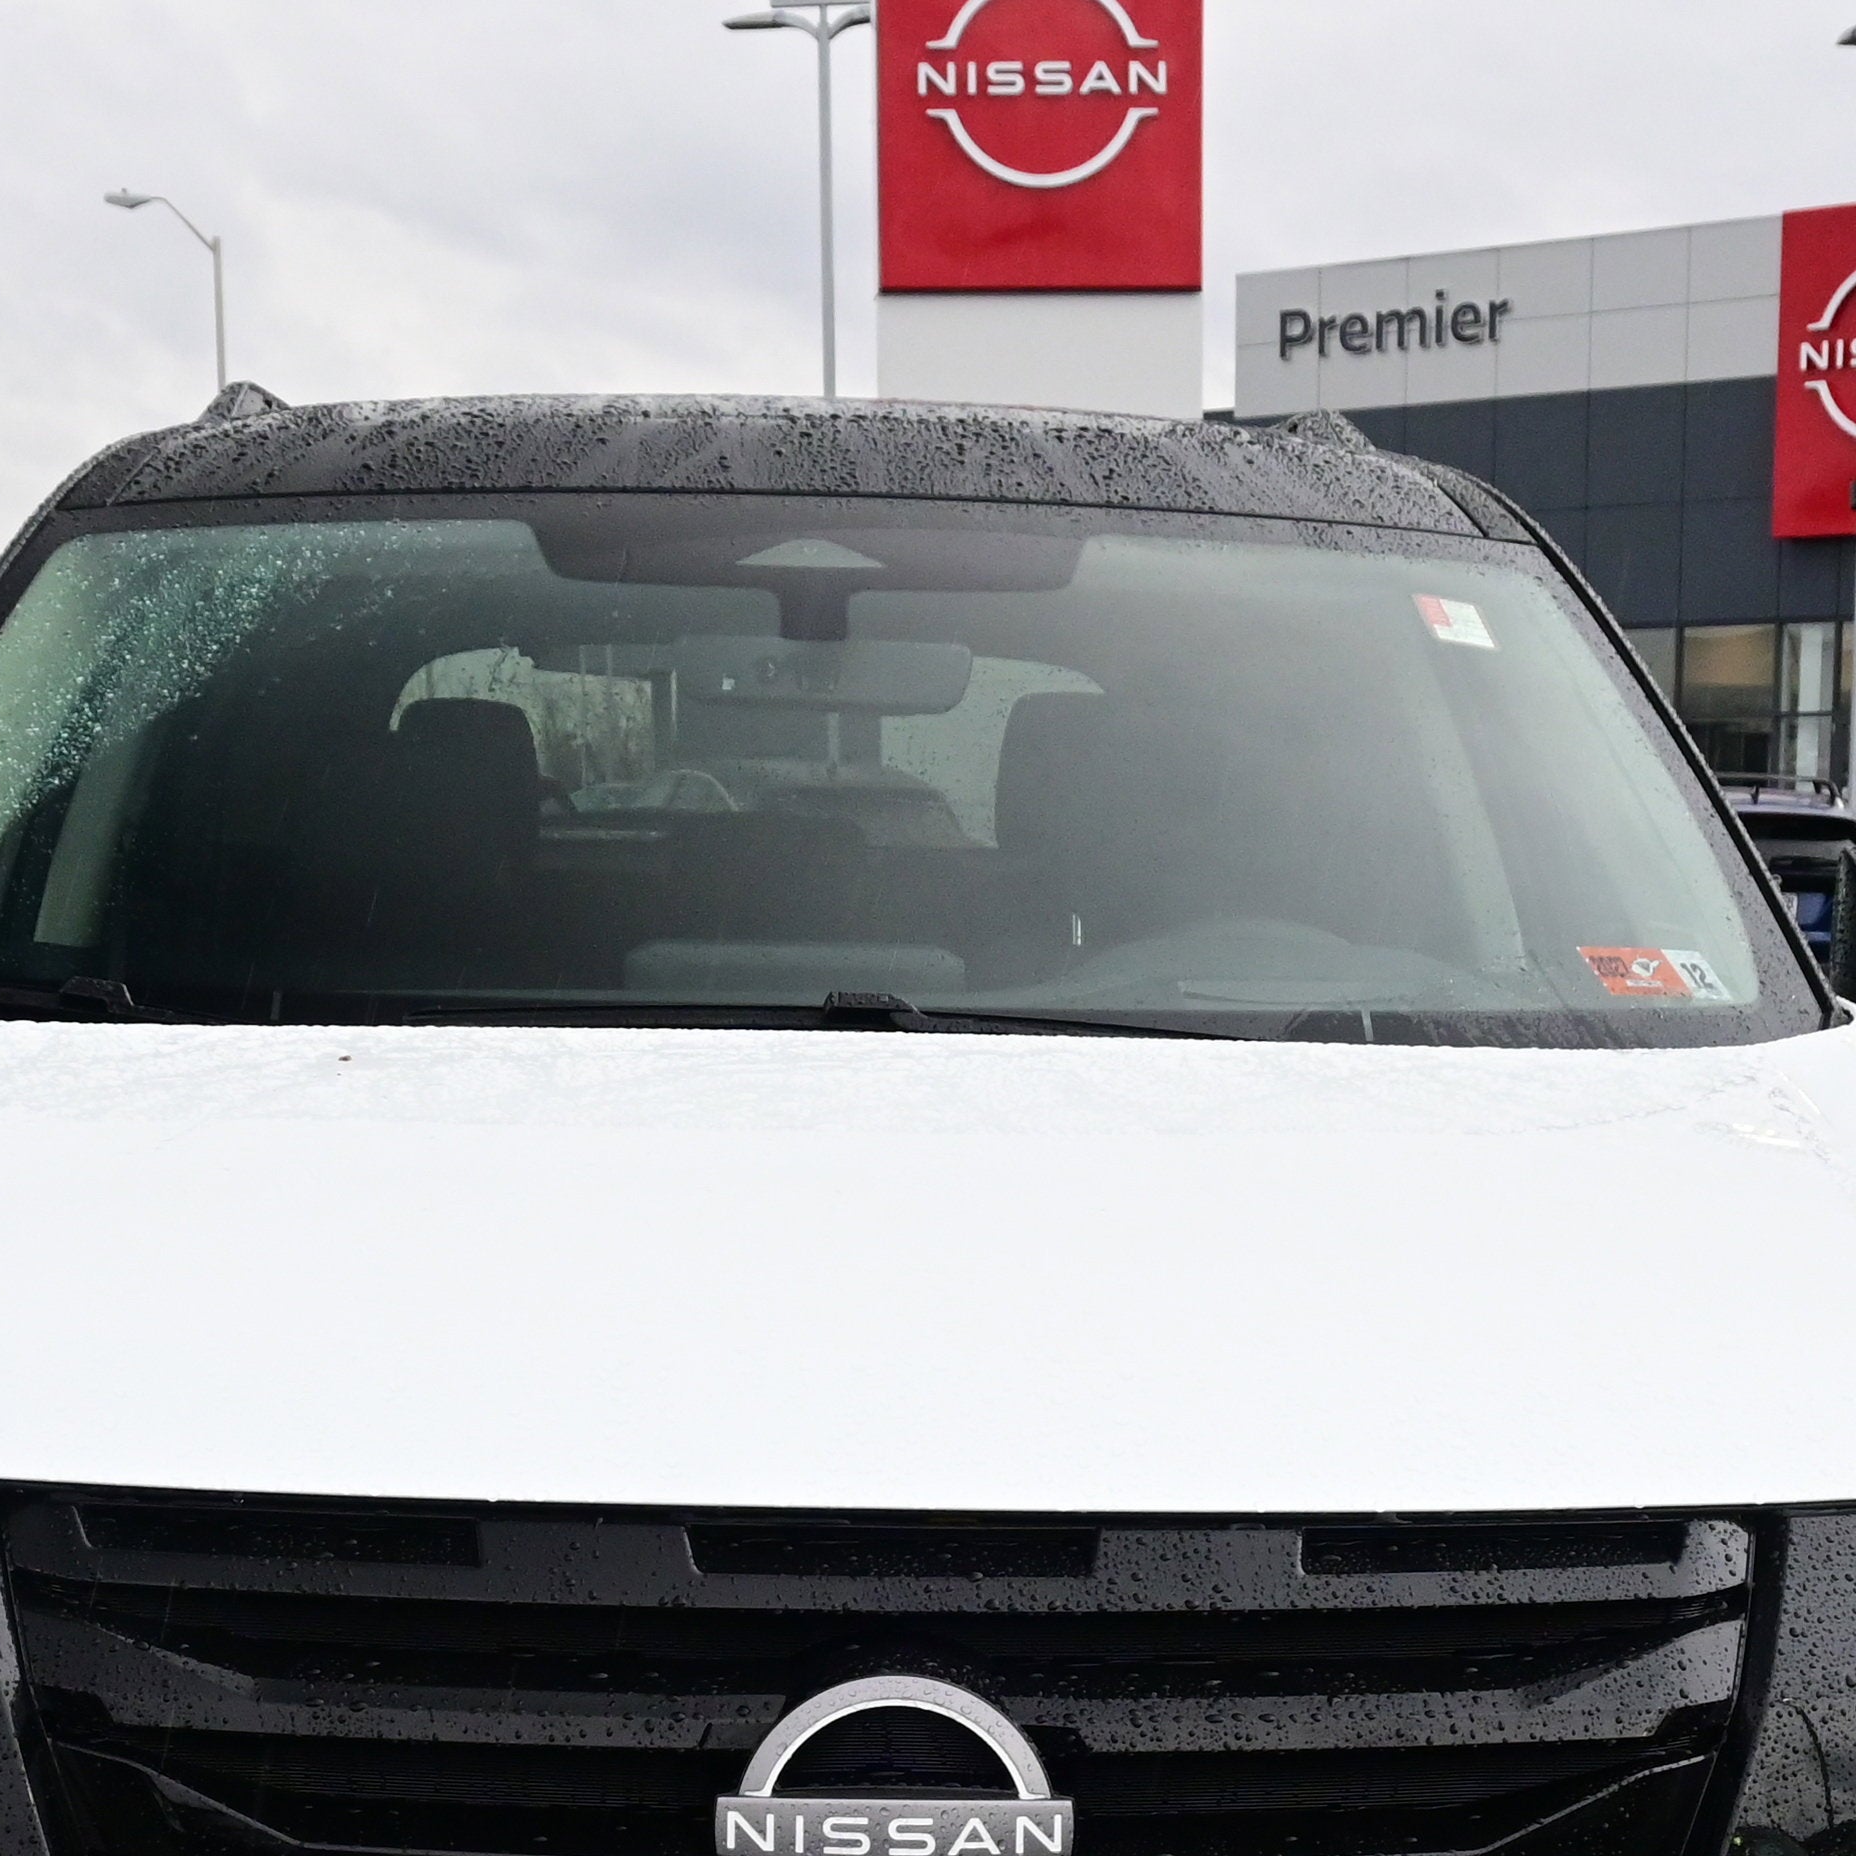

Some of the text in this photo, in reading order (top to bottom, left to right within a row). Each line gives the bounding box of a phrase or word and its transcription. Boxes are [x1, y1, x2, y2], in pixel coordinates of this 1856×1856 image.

[917, 60, 1168, 96] NISSAN
[1279, 288, 1511, 360] Premier
[1680, 963, 1715, 989] 12
[726, 1811, 1063, 1856] NISSAN
